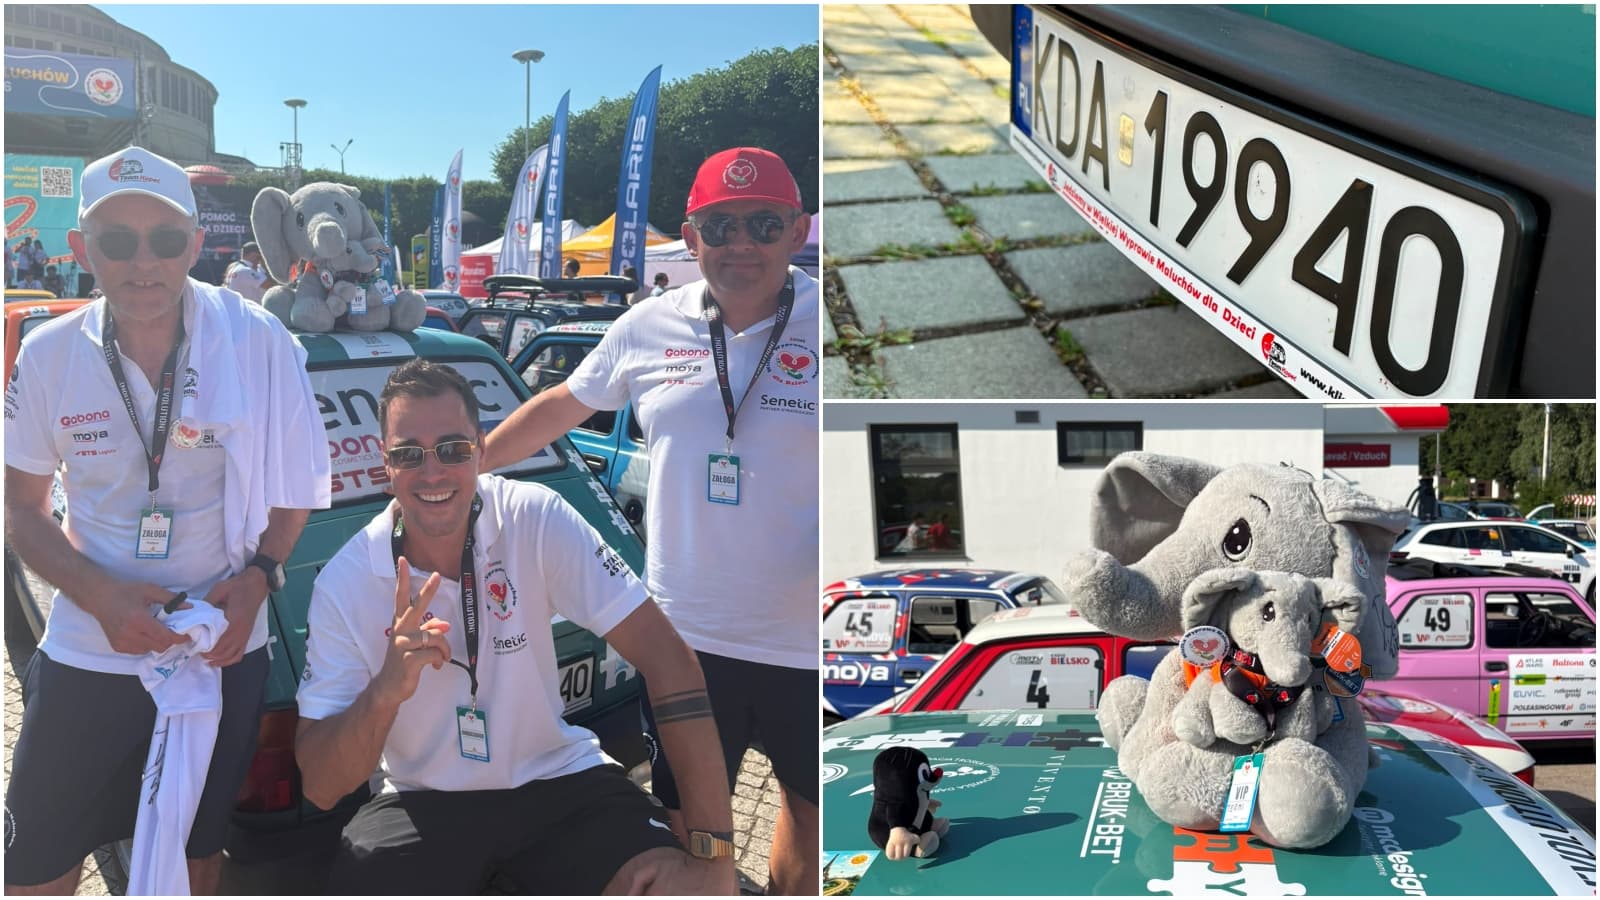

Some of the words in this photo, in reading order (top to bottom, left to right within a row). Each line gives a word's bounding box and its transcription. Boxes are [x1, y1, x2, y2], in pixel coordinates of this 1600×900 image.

[1018, 84, 1031, 113] PL
[1034, 25, 1110, 193] KDA
[1144, 90, 1464, 397] 19940
[1092, 208, 1119, 239] Wielkiej
[1119, 228, 1155, 265] Wyprawie
[1156, 258, 1201, 300] Maluchów
[1202, 294, 1218, 313] dla
[1222, 308, 1256, 340] Dzieci
[760, 394, 816, 411] Senetic
[1353, 450, 1387, 460] Vzduch
[845, 612, 873, 637] 45
[1424, 608, 1451, 632] 49
[559, 664, 588, 702] 40
[1026, 669, 1050, 709] 4
[1235, 785, 1249, 800] VIP
[1090, 781, 1132, 858] BRUK-BET
